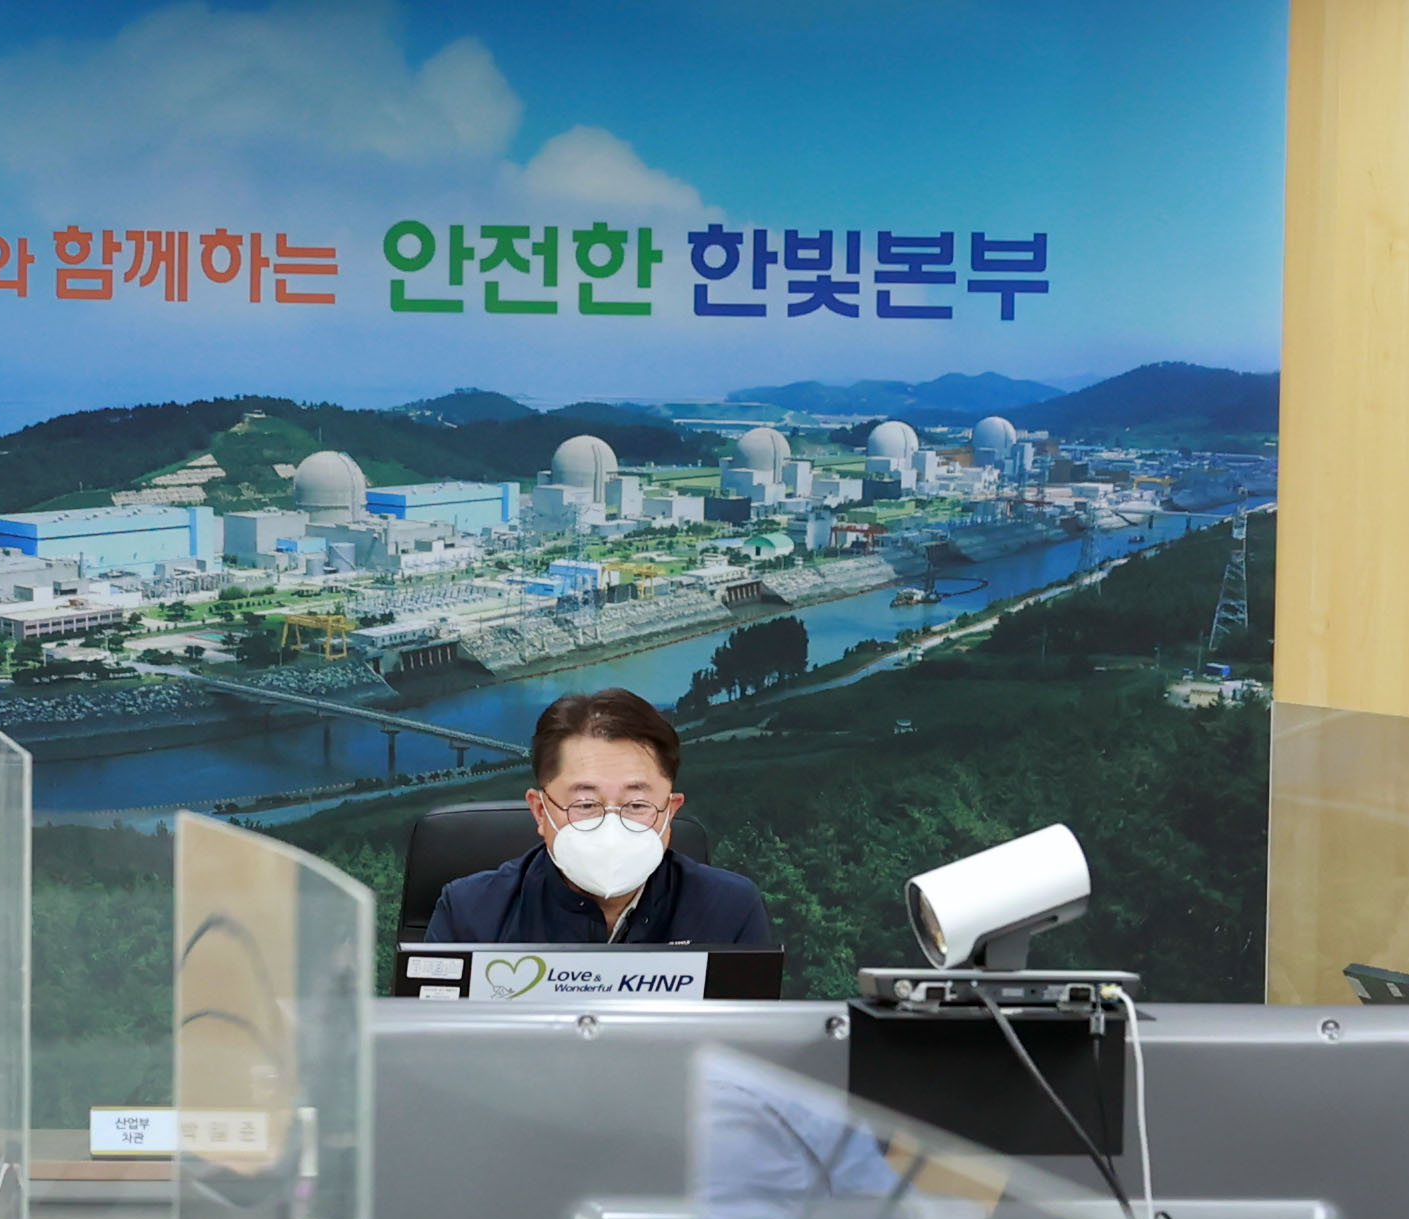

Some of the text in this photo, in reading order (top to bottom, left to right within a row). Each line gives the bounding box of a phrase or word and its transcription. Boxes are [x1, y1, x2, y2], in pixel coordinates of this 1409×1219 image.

[52, 224, 339, 305] 함께하는
[382, 219, 664, 316] 안전한
[687, 222, 1050, 322] 한빛본부
[547, 967, 593, 982] Love
[554, 983, 614, 993] Wonderful
[617, 974, 695, 993] KHNP
[115, 1117, 151, 1130] 산업부
[122, 1131, 144, 1144] 차관
